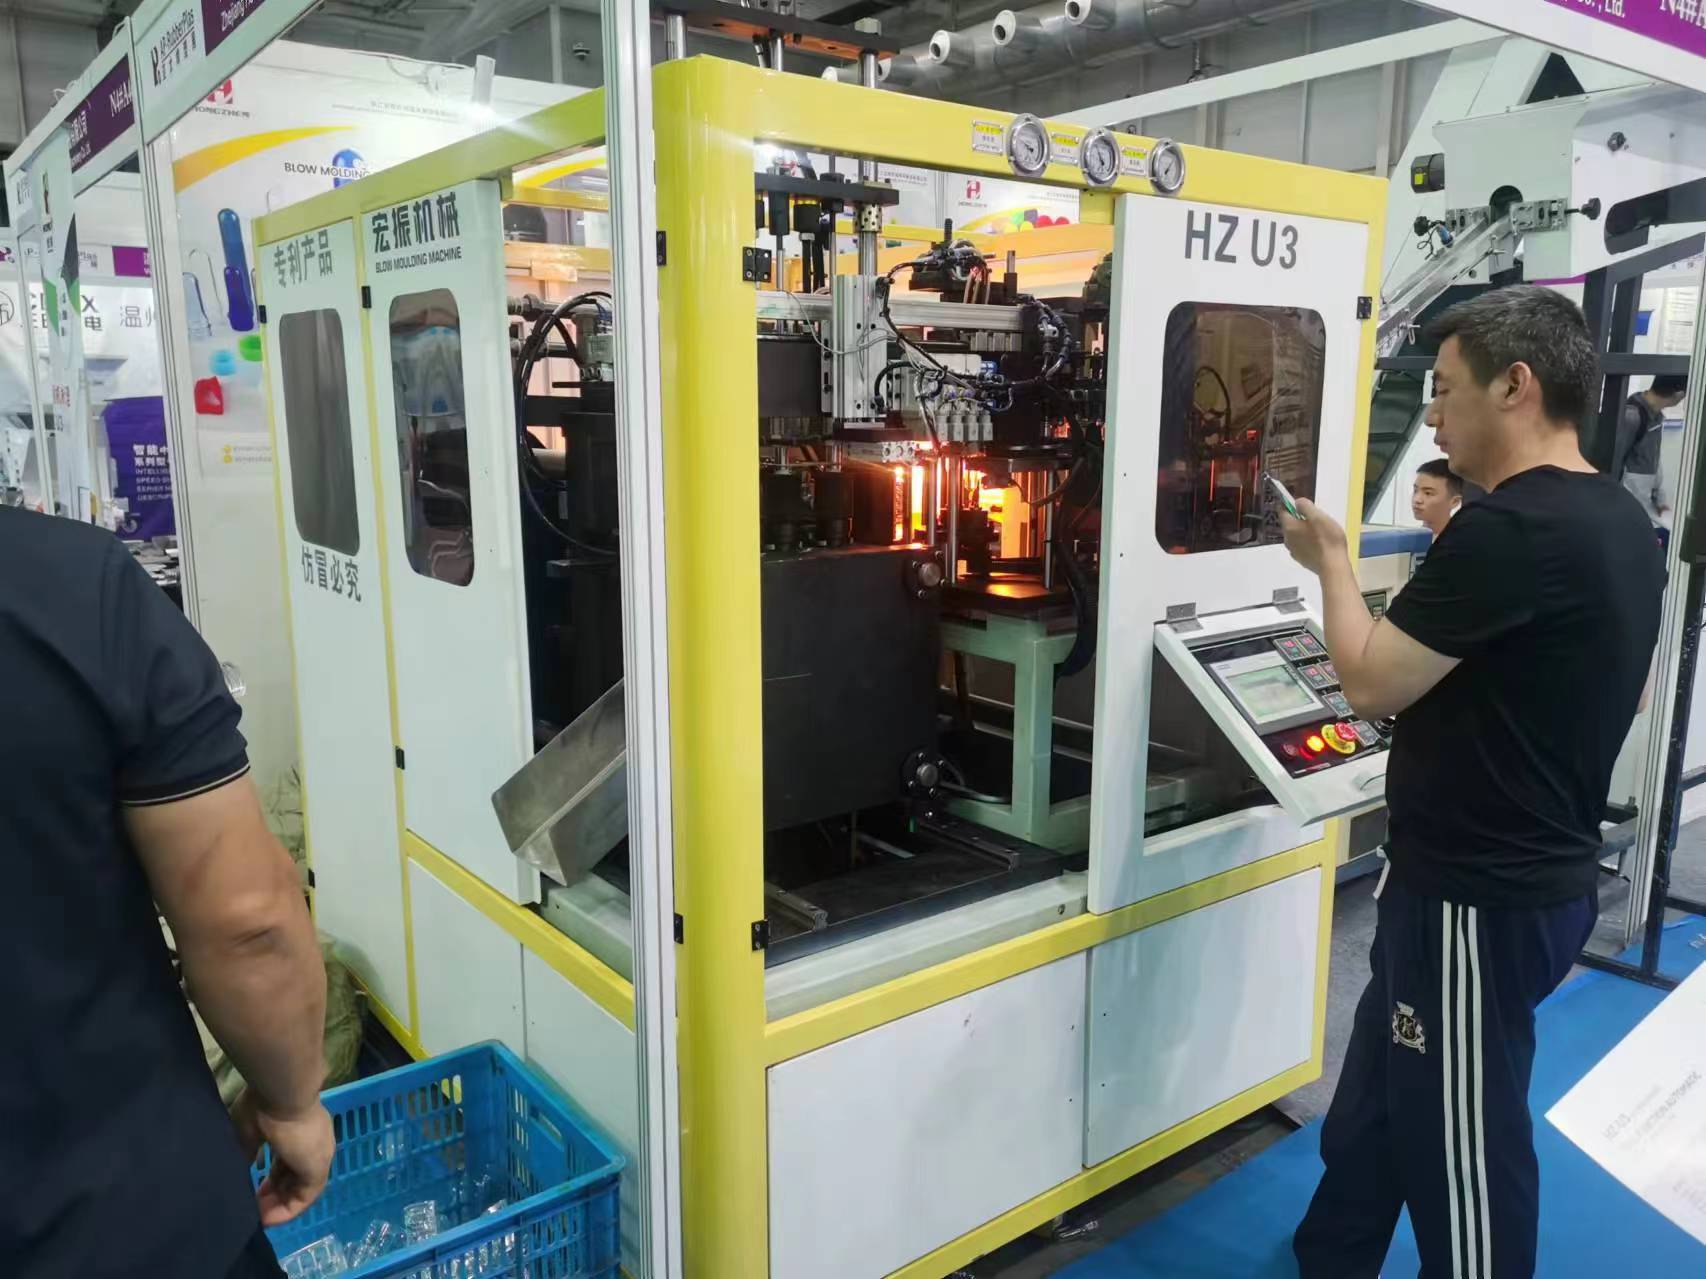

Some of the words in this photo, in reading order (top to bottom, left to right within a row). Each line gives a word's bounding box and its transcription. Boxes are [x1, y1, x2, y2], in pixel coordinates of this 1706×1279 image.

[284, 162, 317, 174] BLOW
[372, 191, 460, 253] 宏振机械
[1185, 209, 1239, 263] HZ
[1251, 218, 1298, 269] U3
[274, 229, 333, 288] 专利产品
[376, 259, 393, 274] BLOW
[393, 252, 428, 270] MOULDING
[428, 246, 462, 265] MACHINE
[302, 544, 361, 602] 仿冒必究
